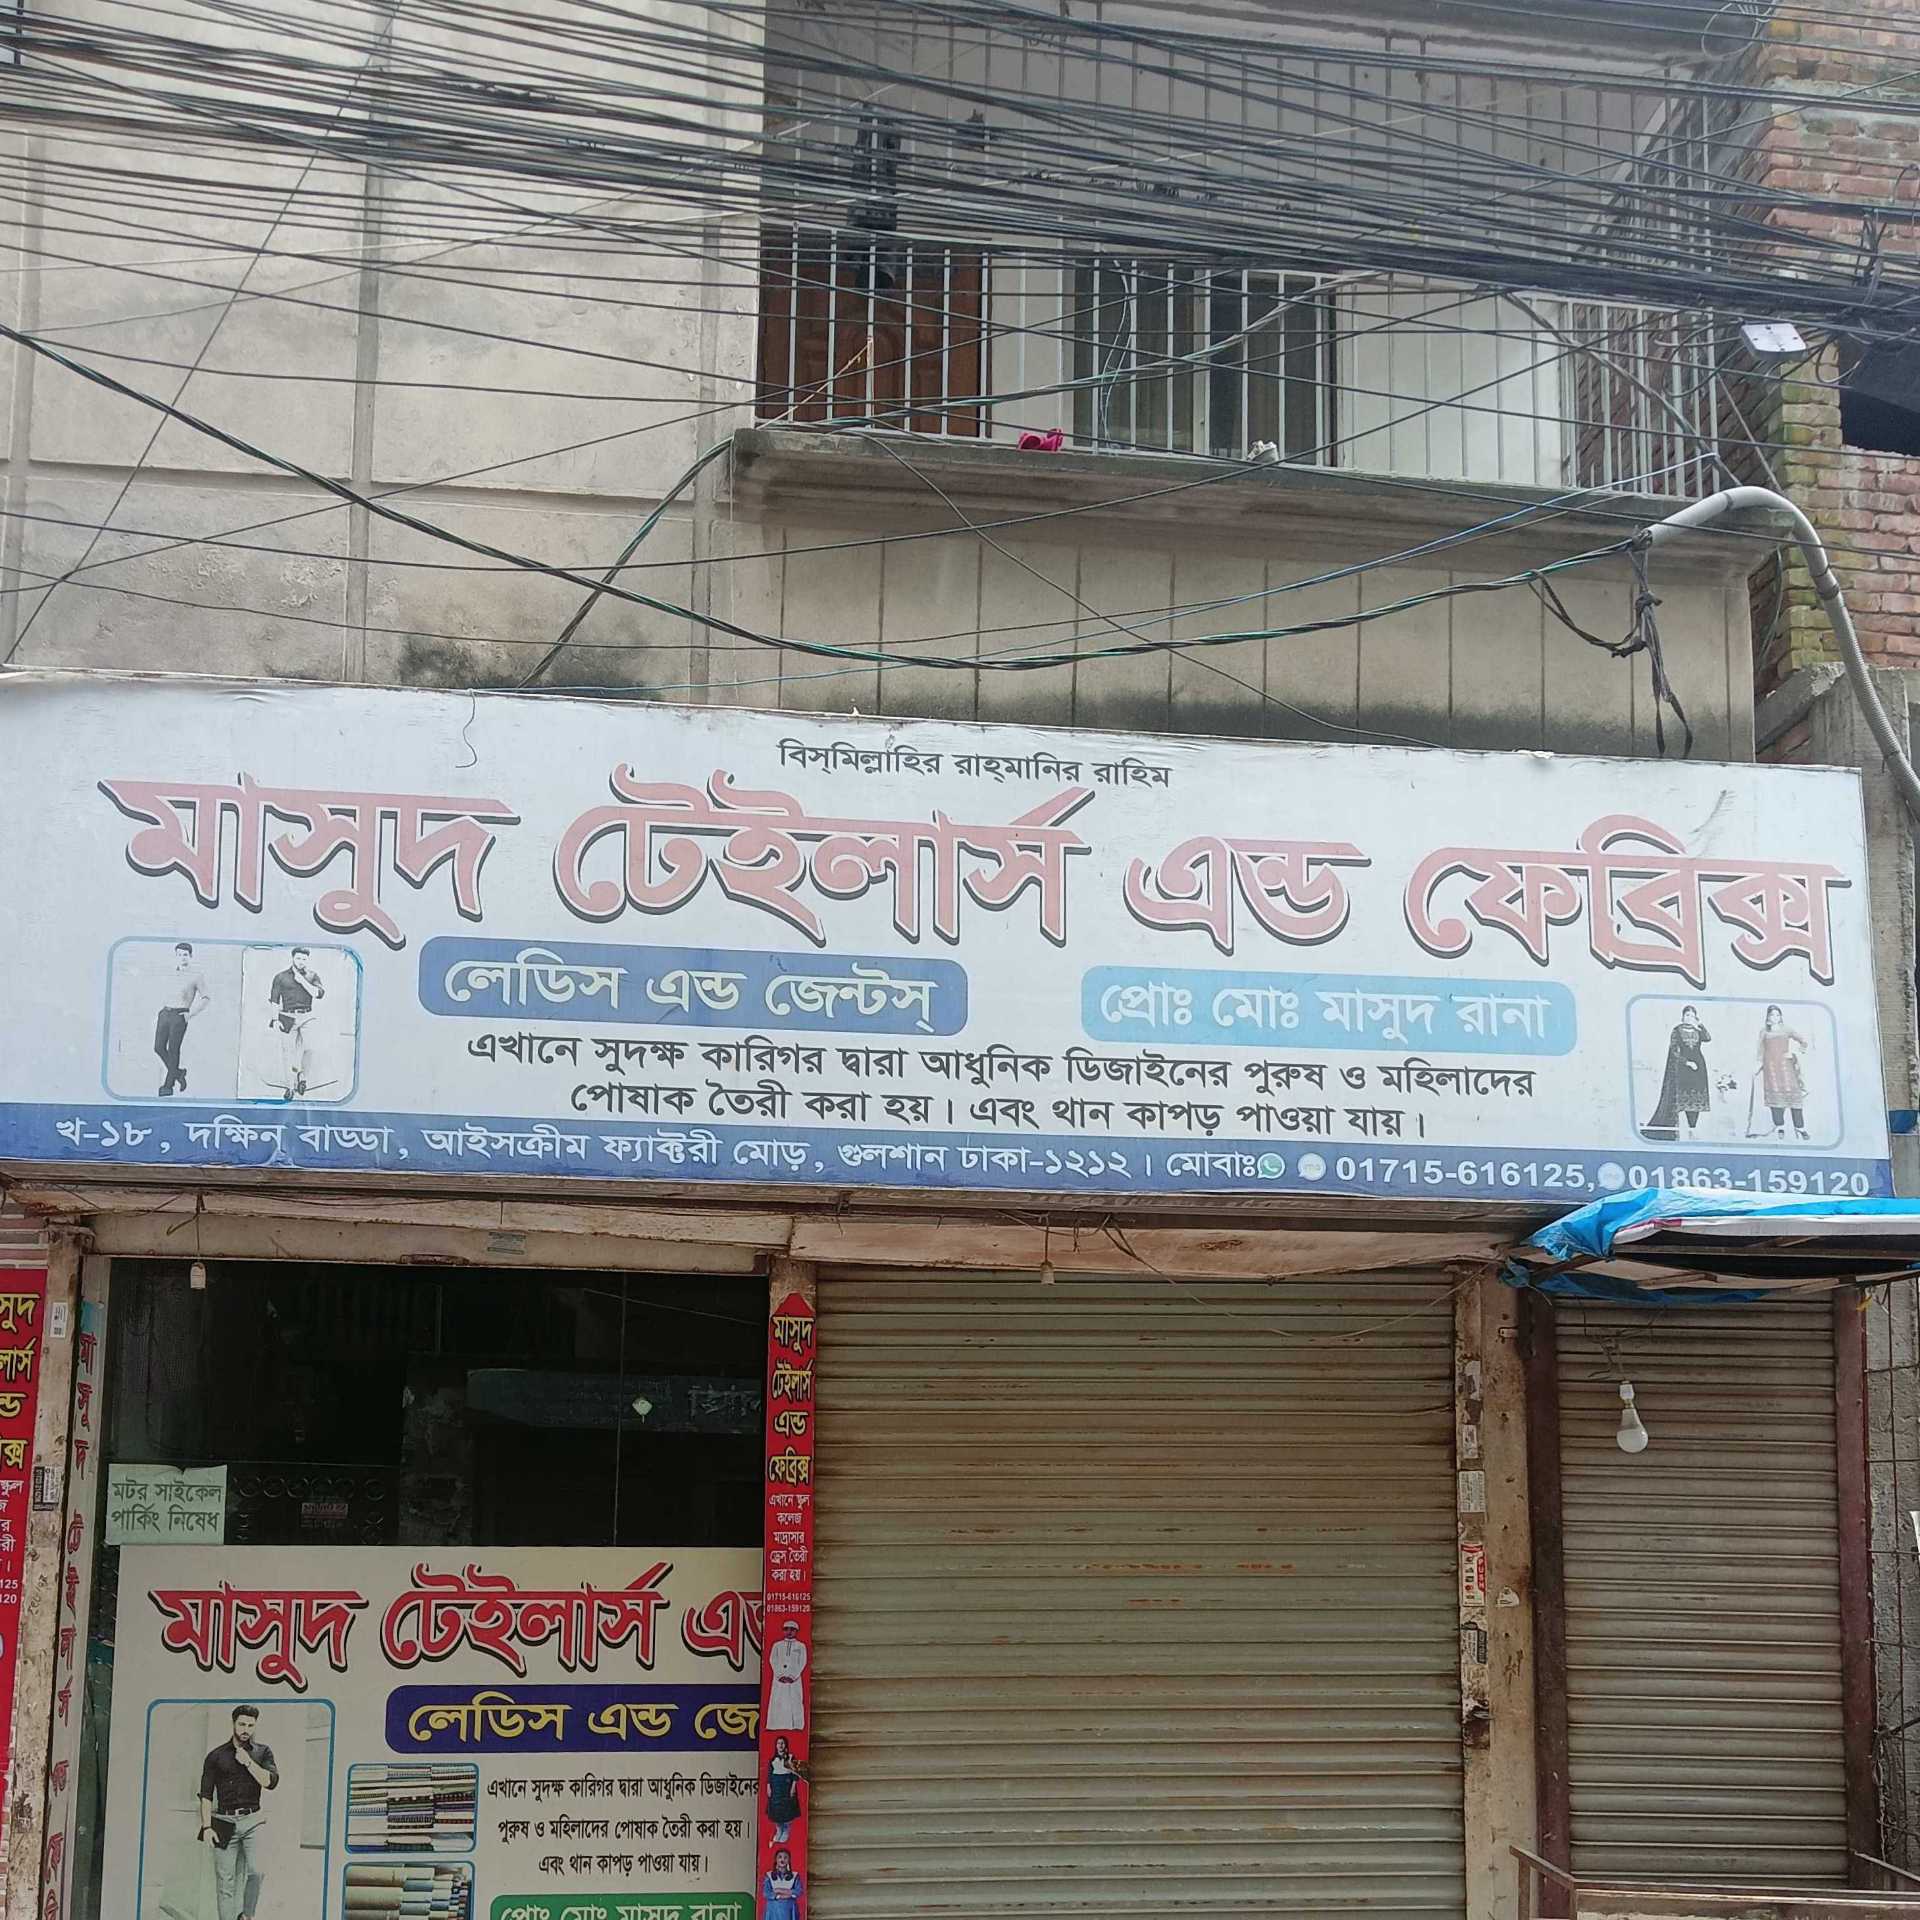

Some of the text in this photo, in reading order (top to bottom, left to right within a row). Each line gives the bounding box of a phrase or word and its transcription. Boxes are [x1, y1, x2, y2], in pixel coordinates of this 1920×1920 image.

[776, 739, 1173, 788] বিস্মিল্লাহির রাহ্মানির রাহিম
[97, 761, 1852, 990] মাসুদ টেইলার্স এন্ড ফেব্রিক্স
[445, 947, 938, 1033] লেডিস এন্ড জেন্টস্
[1100, 981, 1551, 1044] প্রোঃ মোঃ মাসুদ রানা
[467, 1031, 1536, 1096] এখানে সুদক্ষ কারিগর দ্বারা আধুনিক ডিজাইনের পুরুষ ও মহিলাদের
[571, 1081, 697, 1114] পোষাক
[706, 1079, 792, 1119] তৈরী
[800, 1090, 871, 1121] করা
[970, 1097, 1039, 1129] এবং
[1052, 1097, 1115, 1130] থান
[1123, 1100, 1224, 1136] কাপড়
[1236, 1103, 1336, 1135] পাওয়া
[421, 1123, 590, 1159] আইসক্রীম
[599, 1129, 722, 1165] ফ্যাক্টরী
[838, 1143, 949, 1172] গুলশান
[957, 1143, 1132, 1178] ঢাকা-১২১২
[1166, 1149, 1257, 1178] মোবাঃ
[1628, 1165, 1870, 1196] 01863-159120
[0, 1292, 41, 1333] সুদ
[772, 1313, 814, 1352] মাসুদ
[771, 1359, 813, 1401] টেইলার্স
[773, 1408, 809, 1437] এন্ড
[768, 1446, 811, 1486] ফেব্রিক্স
[111, 1476, 223, 1504] মটর সাইকেল
[111, 1503, 220, 1533] পার্কিং নিষেধ
[148, 1580, 369, 1693] মাসুদ
[381, 1562, 673, 1678] টেইলার্স
[408, 1692, 572, 1742] লেডিস
[588, 1703, 680, 1742] এন্ড
[487, 1772, 759, 1802] এখানে সুদক্ষ কারিগর দ্বারা আধুনিক ডিজাইনের
[498, 1819, 529, 1845] পুরুষ
[534, 1822, 545, 1839] ও
[549, 1814, 609, 1841] মহিলাদের
[615, 1819, 658, 1840] পোষাক
[662, 1813, 693, 1840] তৈরী
[696, 1819, 720, 1839] করা
[539, 1854, 565, 1876] এবং
[569, 1853, 592, 1874] থান
[596, 1854, 633, 1877] কাপড়
[638, 1854, 675, 1874] পাওয়া
